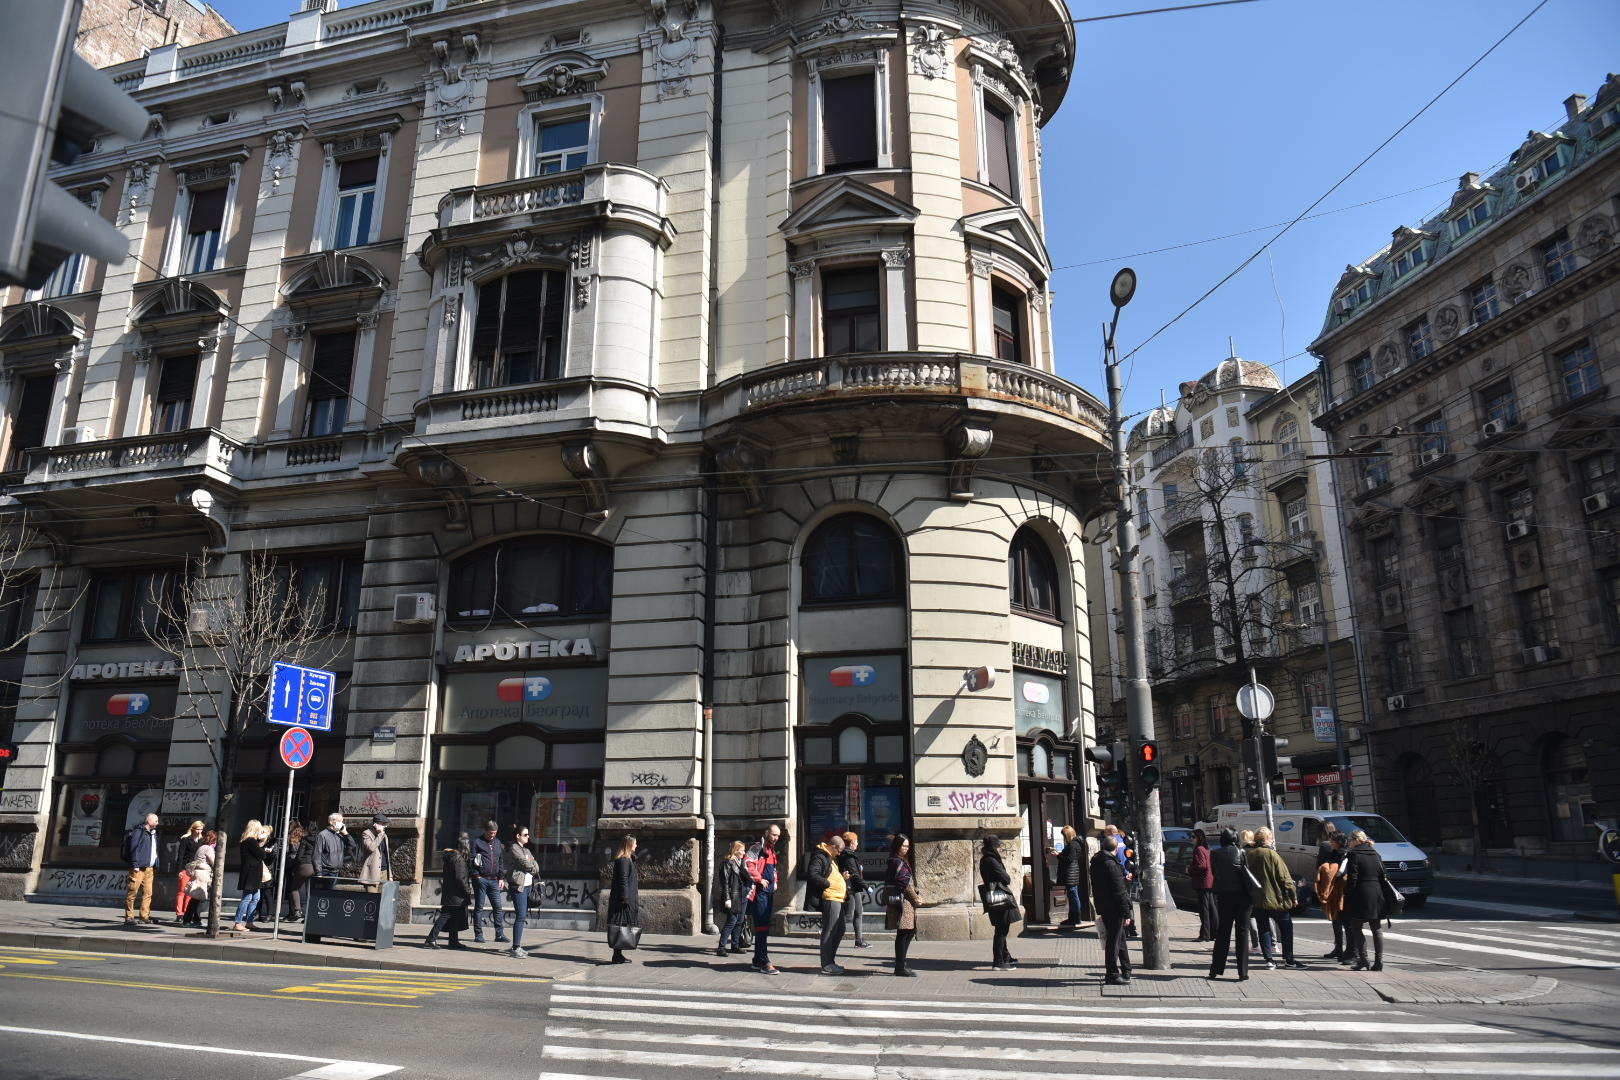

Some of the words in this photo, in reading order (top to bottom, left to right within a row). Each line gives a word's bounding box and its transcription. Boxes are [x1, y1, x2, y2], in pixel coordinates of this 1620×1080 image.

[453, 638, 596, 663] APOTEKA
[70, 659, 178, 680] APOTEKA
[807, 695, 854, 706] Pharmacy
[856, 692, 899, 706] Belgrade
[458, 705, 520, 720] Апотека
[526, 703, 590, 720] Београд
[1315, 771, 1341, 784] Jasmil
